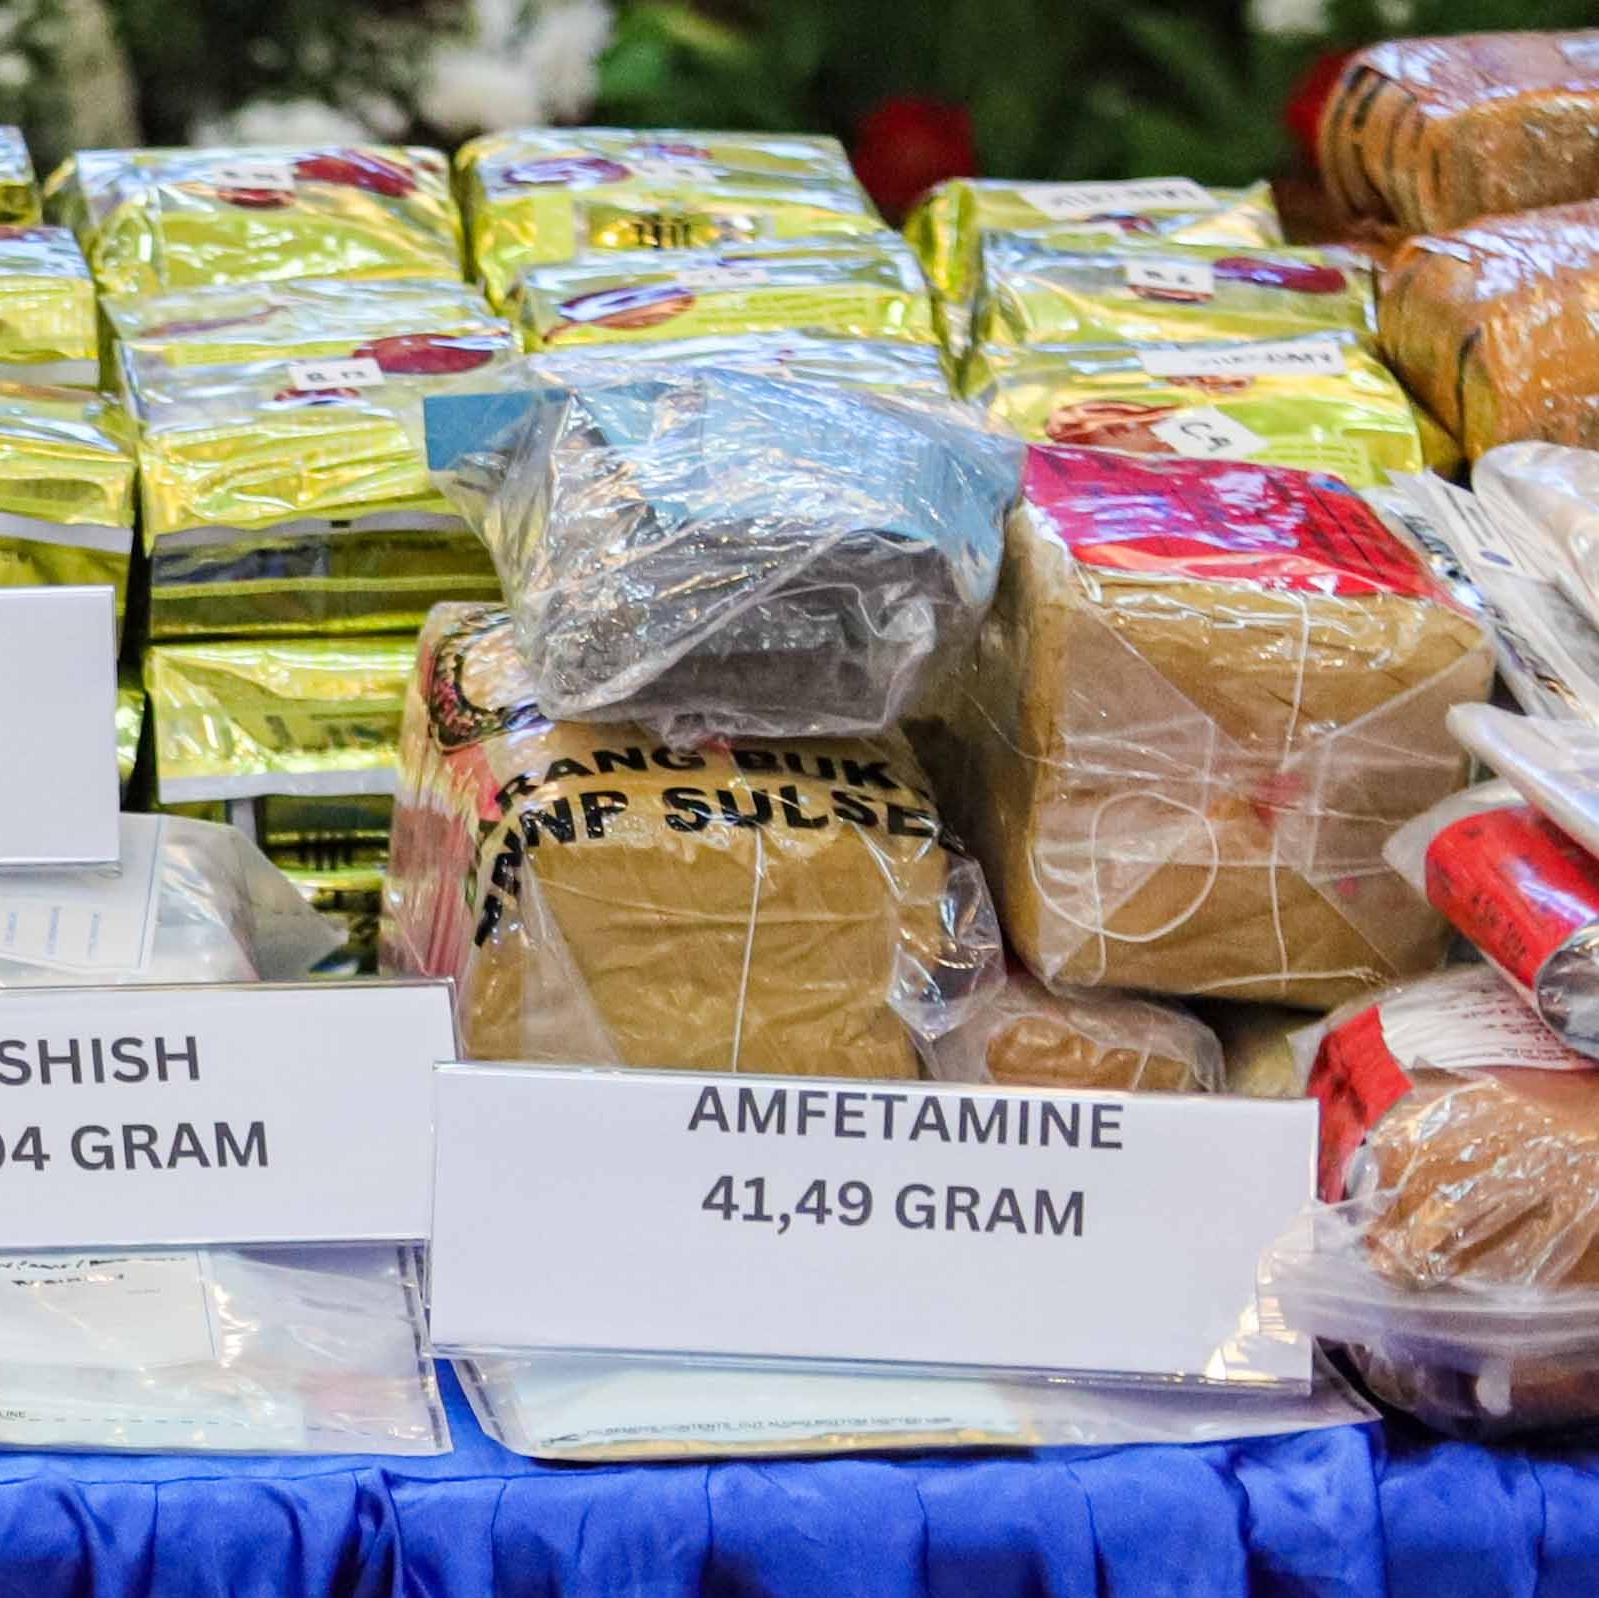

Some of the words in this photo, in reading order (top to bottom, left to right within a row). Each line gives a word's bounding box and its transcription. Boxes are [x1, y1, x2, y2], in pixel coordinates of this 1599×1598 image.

[70, 1121, 270, 1171] GRAM
[687, 1085, 1126, 1150] AMFETAMINE
[701, 1175, 874, 1235] 41,49
[895, 1183, 1087, 1237] GRAM
